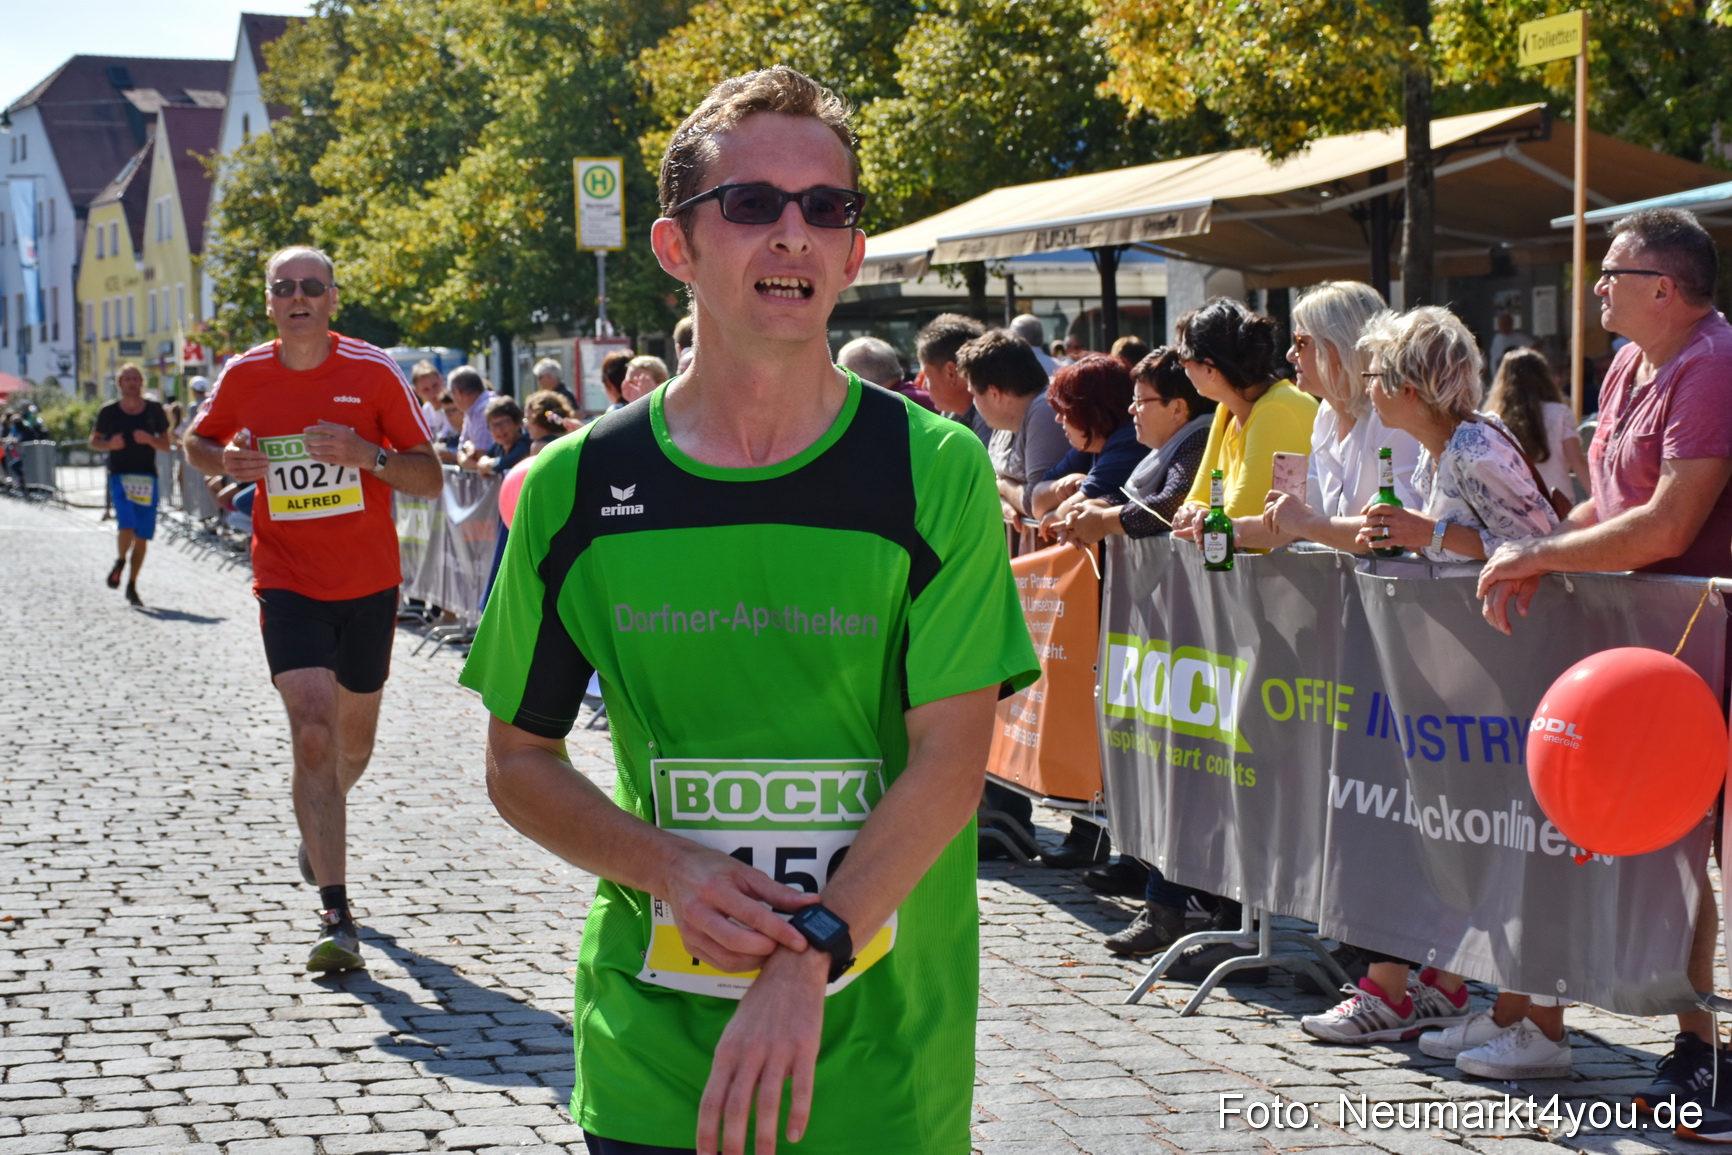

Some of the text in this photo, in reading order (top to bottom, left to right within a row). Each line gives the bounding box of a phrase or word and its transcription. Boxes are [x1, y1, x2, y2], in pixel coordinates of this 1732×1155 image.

[1531, 28, 1579, 51] Toiletten
[333, 395, 361, 403] adidas
[274, 463, 345, 491] 1027
[287, 494, 341, 510] ALFRED
[601, 504, 644, 516] erima
[614, 601, 878, 638] Dorfner-Apotheken
[1543, 734, 1580, 749] energie
[675, 777, 866, 816] BOCK
